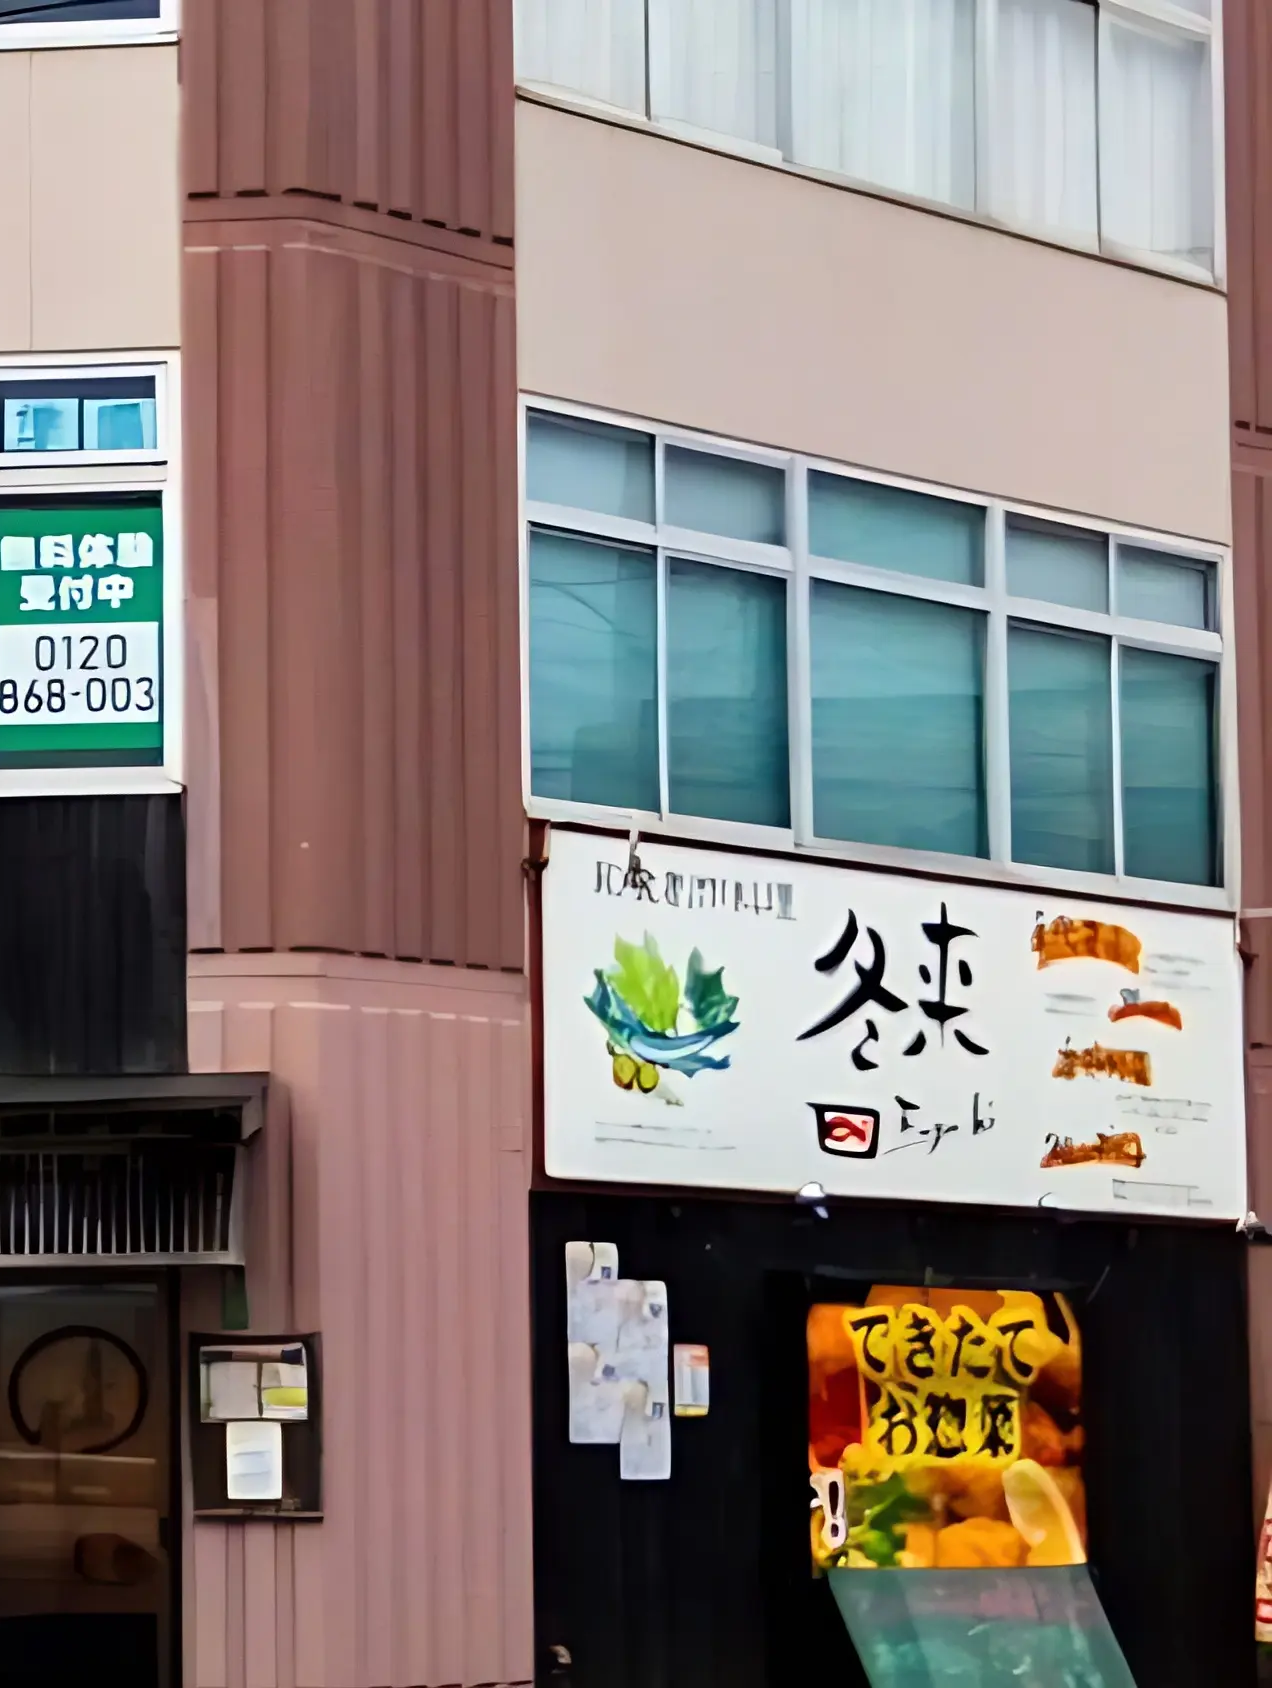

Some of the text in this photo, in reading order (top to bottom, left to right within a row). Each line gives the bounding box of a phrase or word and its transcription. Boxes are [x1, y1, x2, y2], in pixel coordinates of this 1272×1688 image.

[35, 634, 127, 671] 0120
[0, 677, 154, 713] 868-003
[795, 901, 990, 1071] 冬来
[849, 1312, 1036, 1378] できたて
